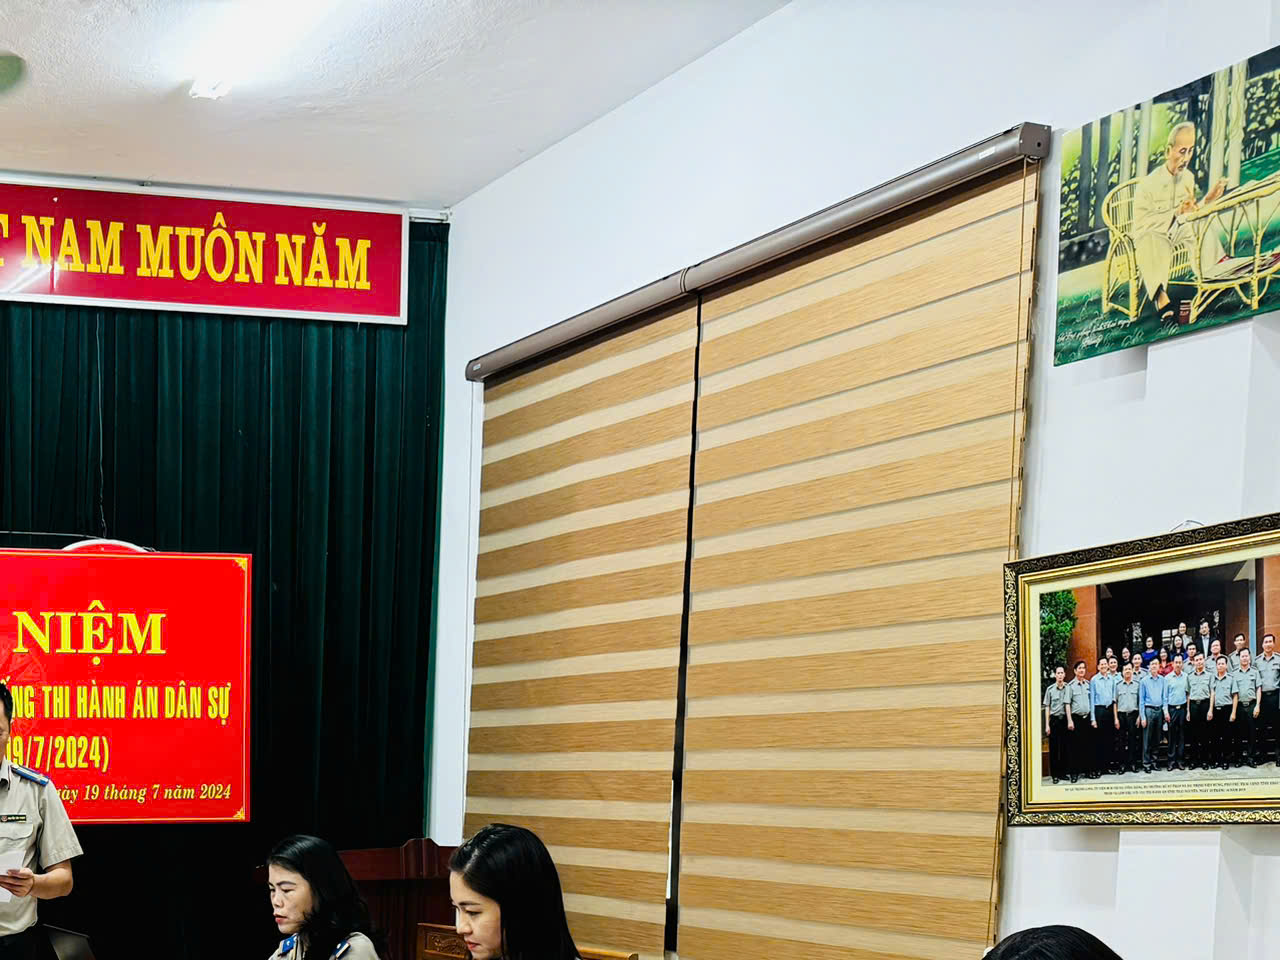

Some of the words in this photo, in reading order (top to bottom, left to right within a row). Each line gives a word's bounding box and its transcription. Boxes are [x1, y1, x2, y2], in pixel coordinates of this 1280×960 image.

[21, 214, 125, 275] NAM
[136, 211, 266, 284] MUÔN
[275, 222, 372, 291] NĂM
[12, 599, 168, 666] NIỆM
[41, 684, 71, 719] THI
[76, 678, 126, 719] HÀNH
[132, 678, 159, 719] ÁN
[164, 678, 202, 719] DÂN
[207, 681, 232, 726] SỰ
[84, 784, 100, 801] 19
[104, 784, 148, 804] tháng
[152, 784, 161, 800] 7
[164, 784, 195, 800] năm
[200, 783, 232, 800] 2024
